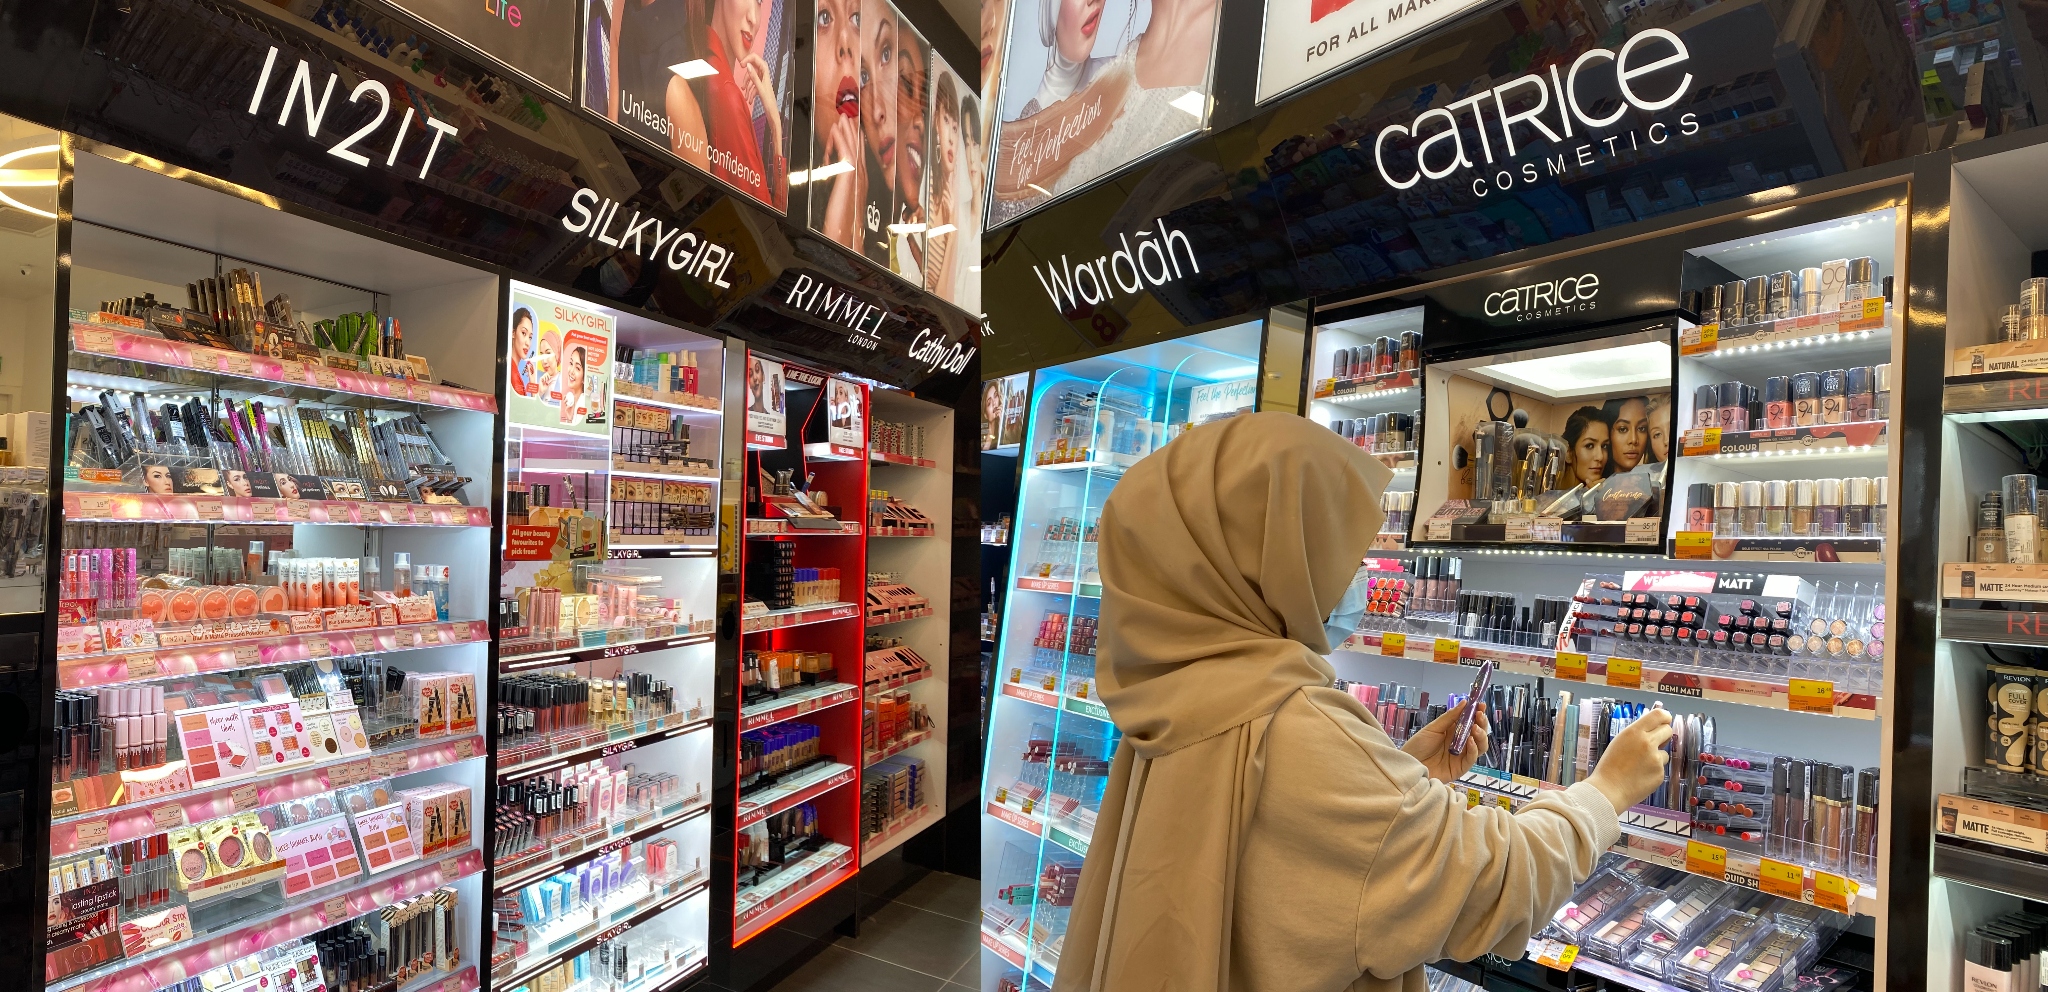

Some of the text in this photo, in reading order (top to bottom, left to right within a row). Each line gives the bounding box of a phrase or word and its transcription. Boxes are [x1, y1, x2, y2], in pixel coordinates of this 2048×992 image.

[1306, 0, 1437, 63] FOR ALL MA
[248, 45, 458, 180] IN2IT
[621, 89, 761, 188] Unleash your confidence
[1010, 95, 1102, 175] Feel Perfection
[1473, 113, 1699, 197] COSMETICS
[1017, 162, 1032, 189] the
[562, 187, 736, 289] SILKYGIRL
[785, 274, 888, 341] RIMMEL
[1516, 301, 1596, 322] COSMETICS
[554, 306, 611, 333] SILKYGIRL
[847, 332, 879, 352] LONDON
[1989, 361, 2019, 370] NATURAL
[798, 373, 808, 383] THE
[808, 375, 823, 386] LOOK
[1196, 386, 1210, 404] Feel
[1211, 386, 1221, 401] the
[1722, 444, 1757, 452] COLOUR
[532, 530, 550, 539] beauty
[1719, 578, 1753, 590] MATT
[1980, 583, 2003, 592] MATTE
[832, 690, 853, 701] RIML
[1032, 692, 1044, 701] SERIES
[1660, 684, 1701, 697] DEMI MATT
[1001, 810, 1012, 819] MAKE
[1016, 816, 1029, 828] SERIES
[1962, 820, 1989, 834] MATTE
[1724, 873, 1744, 885] QUID
[172, 912, 186, 923] STIX
[169, 922, 186, 933] matte
[1722, 917, 1750, 935] BEIG
[983, 935, 992, 946] MAKE
[1766, 932, 1792, 948] BEIG
[1972, 976, 1997, 989] REVLON
